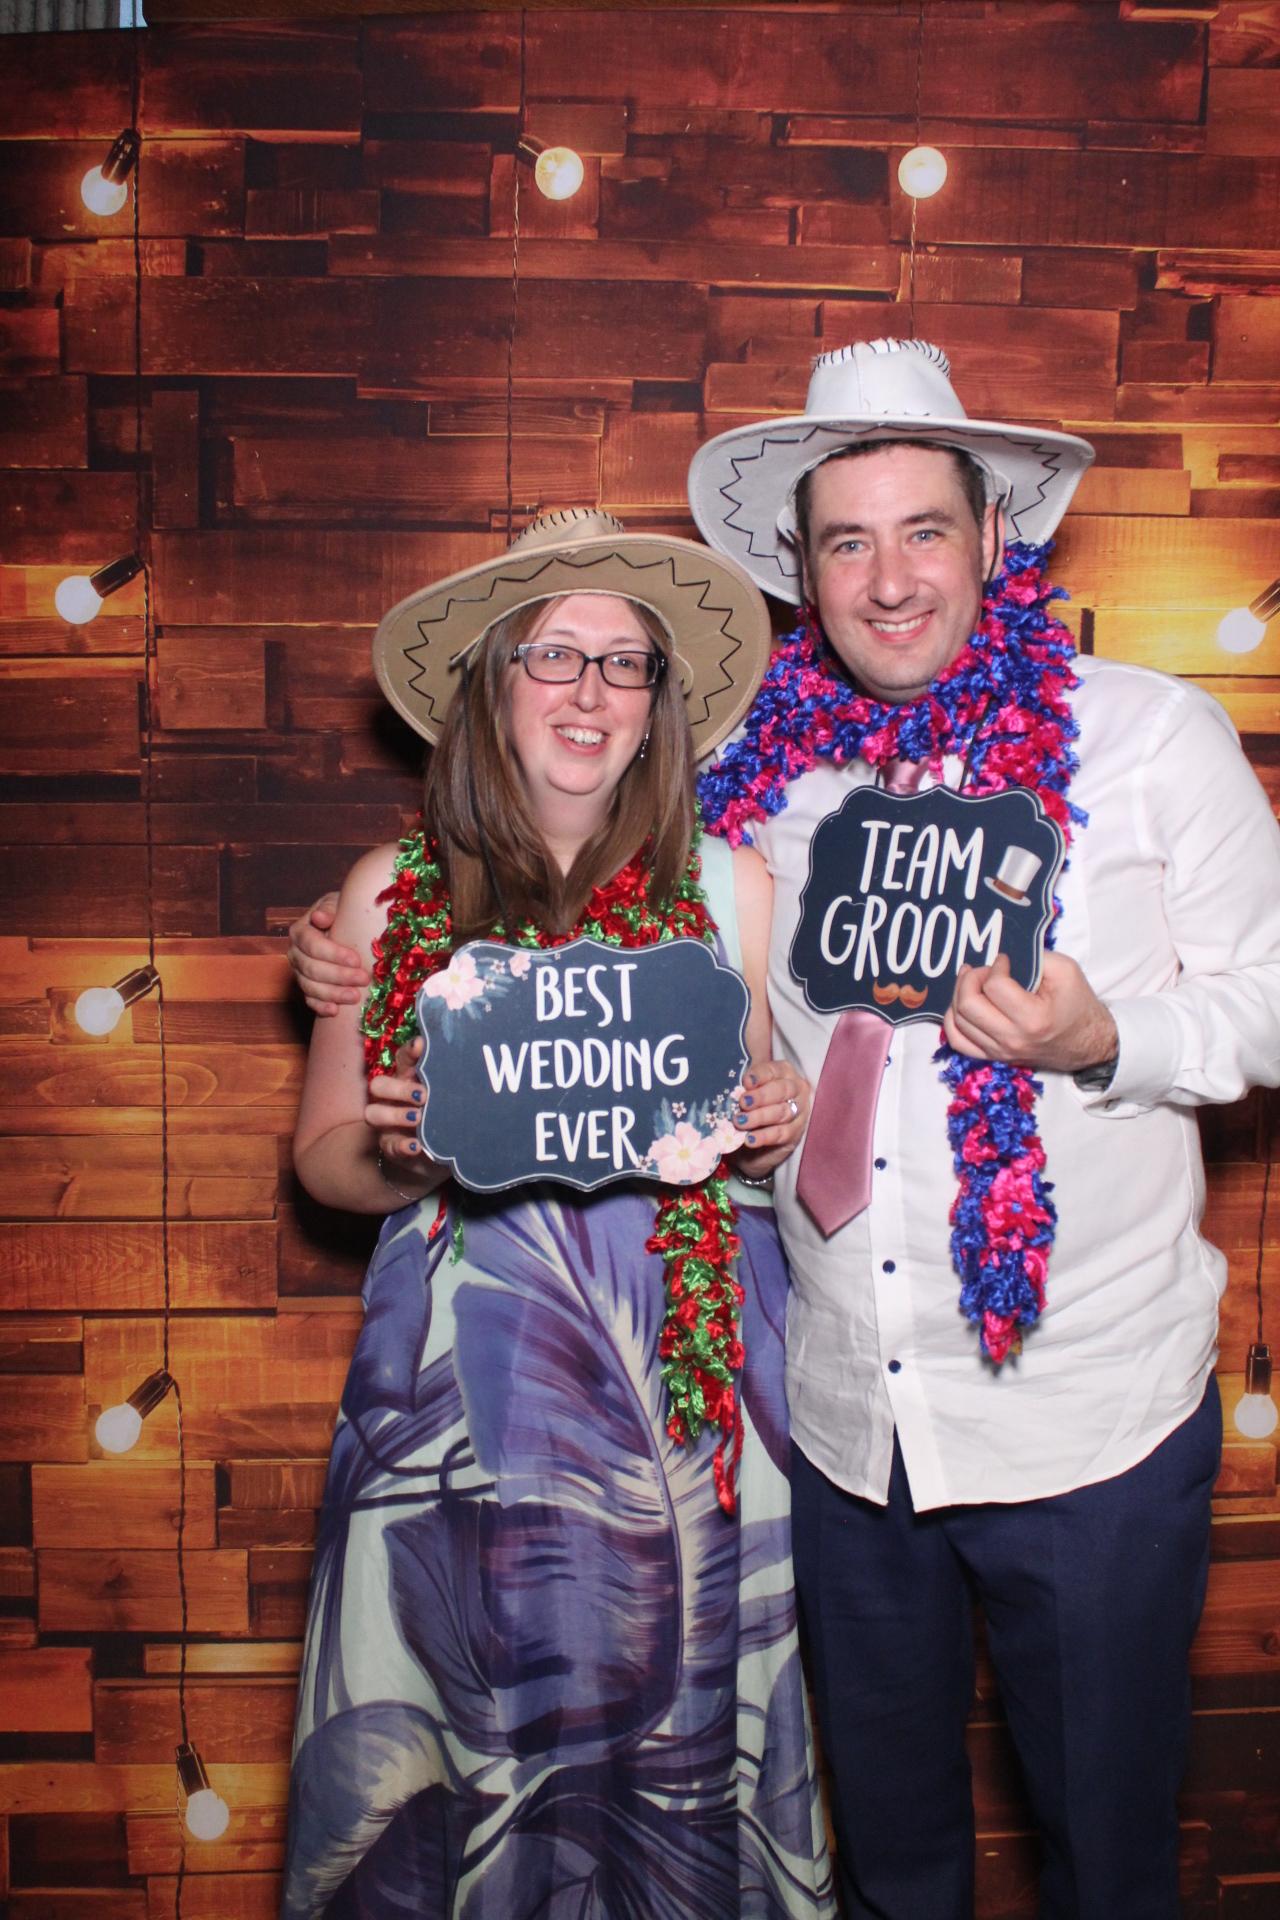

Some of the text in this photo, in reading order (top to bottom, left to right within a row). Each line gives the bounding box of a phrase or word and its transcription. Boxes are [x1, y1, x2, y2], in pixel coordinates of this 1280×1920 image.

[859, 820, 984, 900] TEAM
[820, 894, 1003, 982] GROOM
[535, 963, 638, 1028] BEST
[482, 1033, 690, 1094] WEDDING
[535, 1106, 640, 1170] EVER
